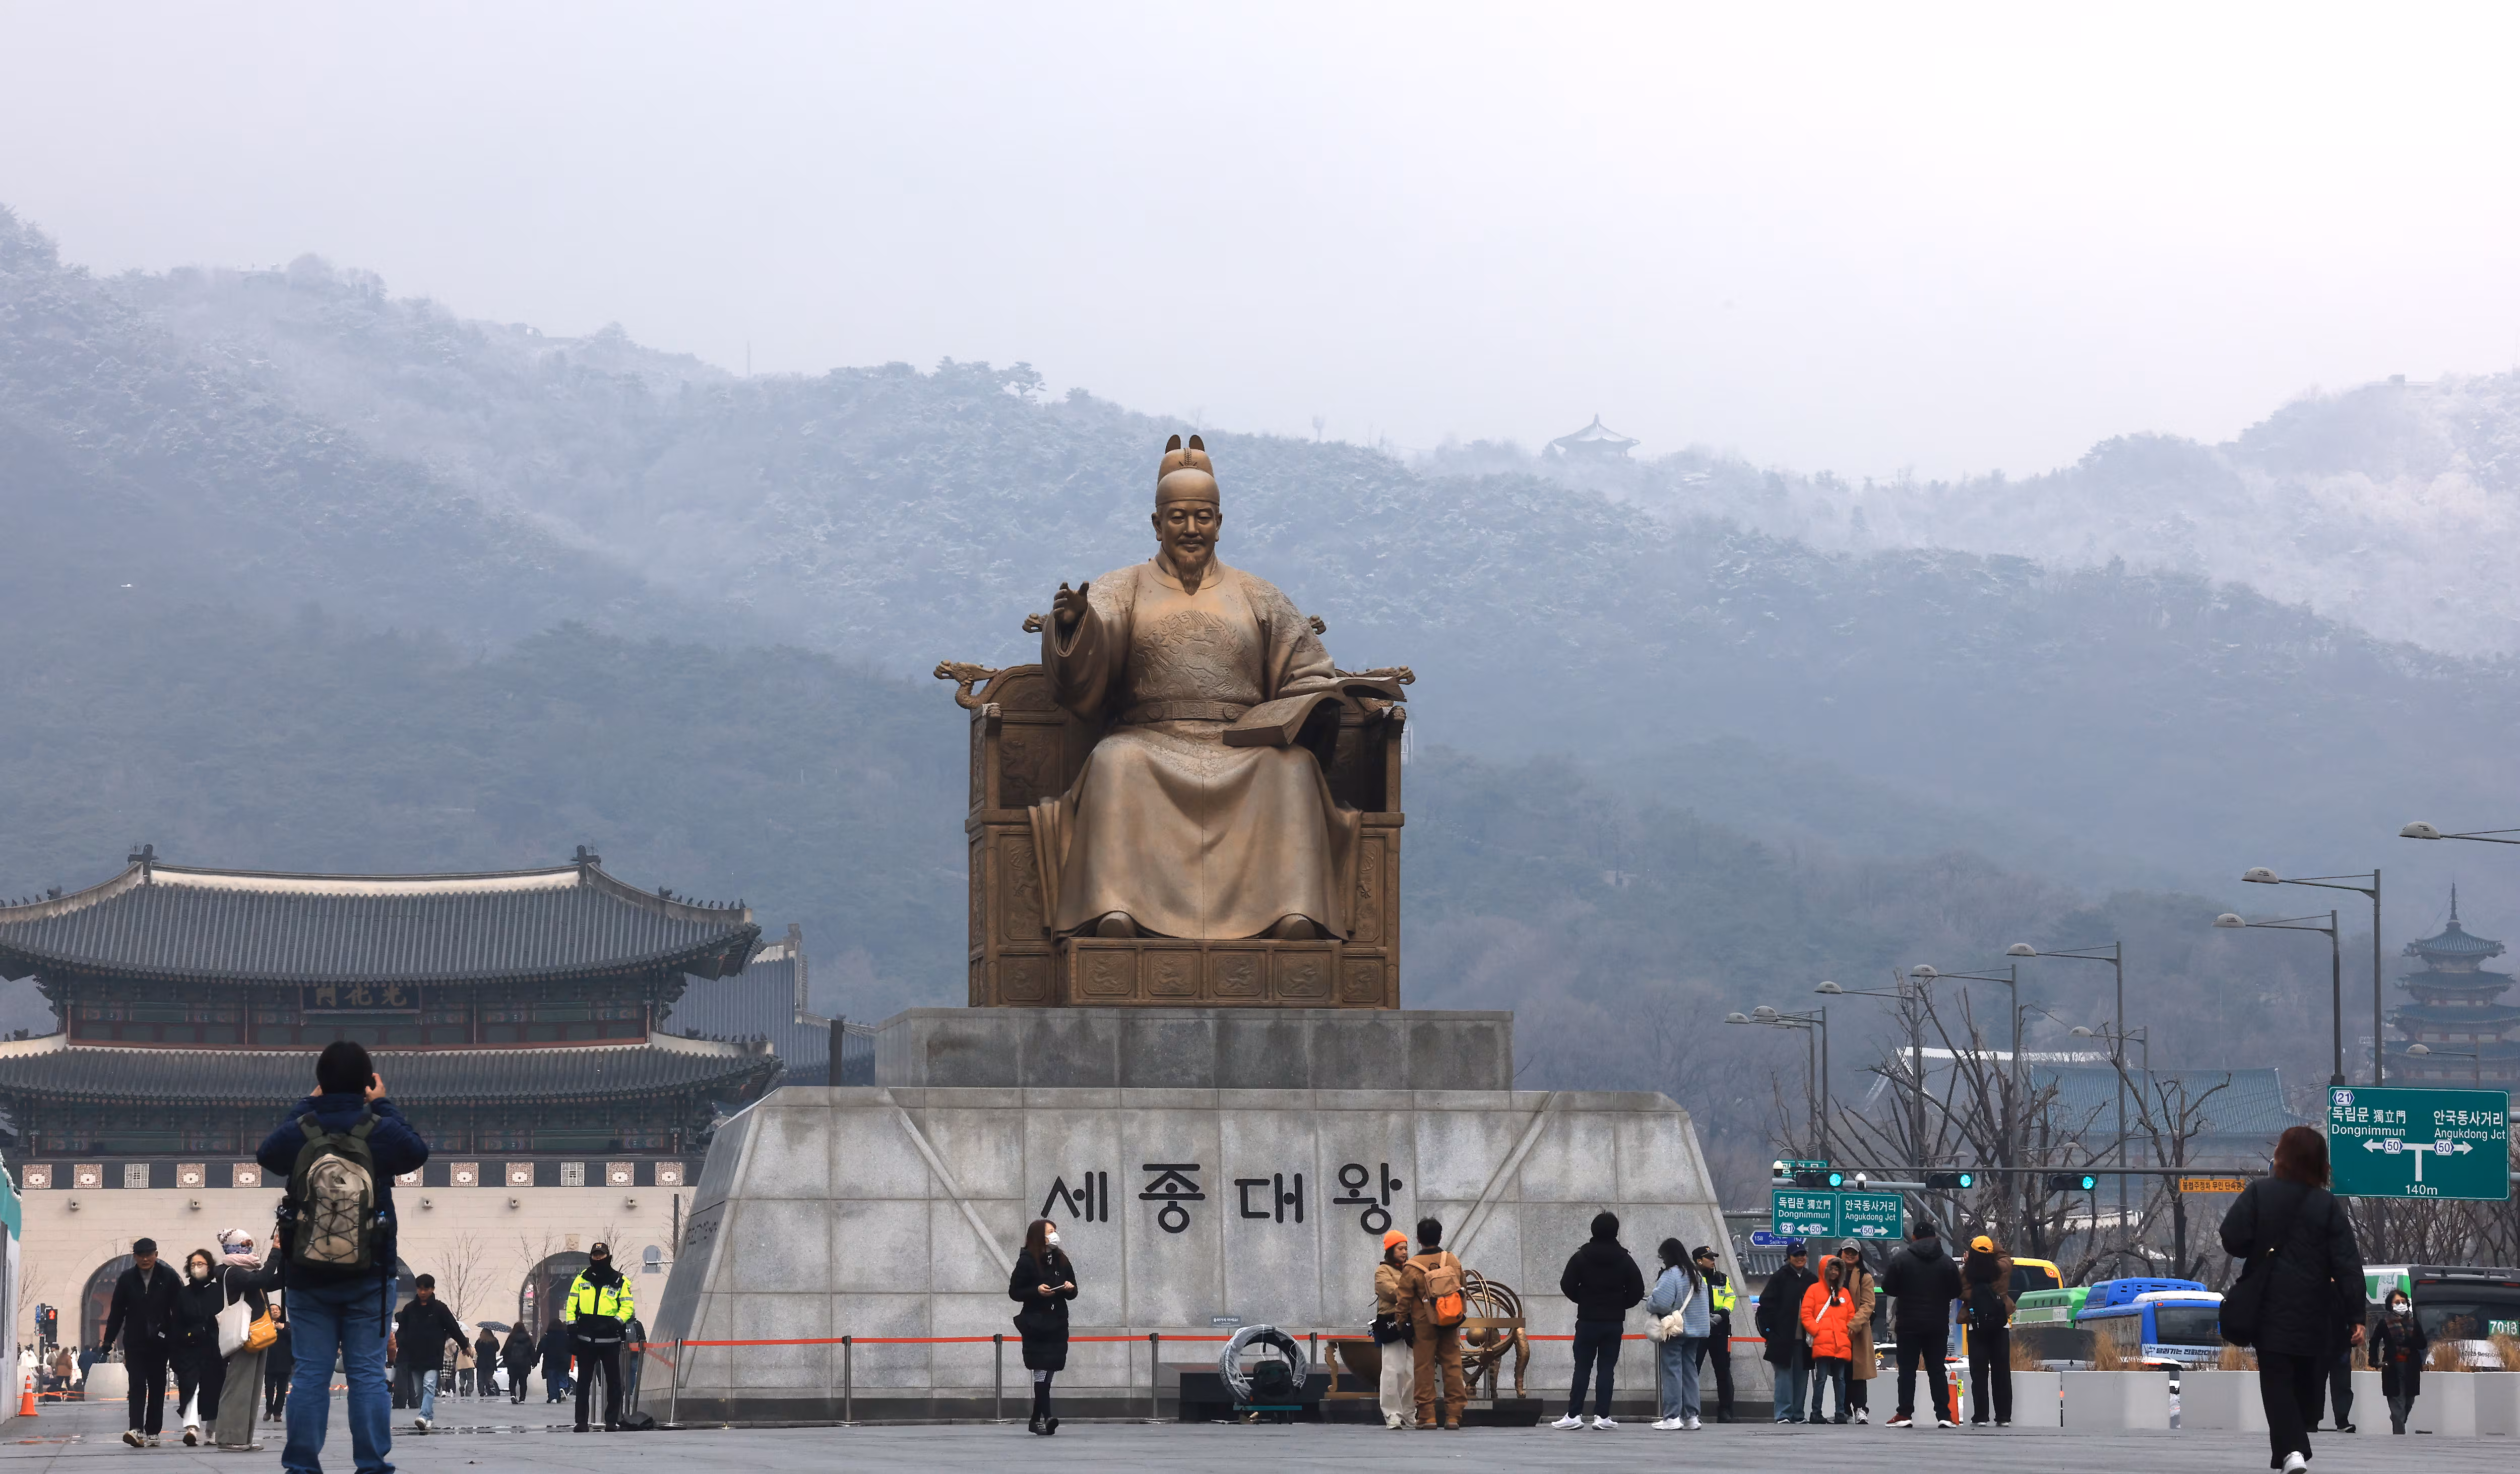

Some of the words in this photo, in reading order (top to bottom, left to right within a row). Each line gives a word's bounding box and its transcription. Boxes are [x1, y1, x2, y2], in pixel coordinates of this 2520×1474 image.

[2338, 1093, 2350, 1103] 21
[2332, 1106, 2369, 1123] 독립문
[2373, 1109, 2406, 1124] 獨立門
[2434, 1110, 2503, 1127] 안국동사거리
[2332, 1124, 2406, 1137] Dongnimmun
[2434, 1128, 2487, 1141] Angukdong
[2491, 1130, 2506, 1140] Jct
[2387, 1139, 2399, 1151] 50
[2438, 1142, 2450, 1153] 50
[2182, 1181, 2211, 1190] 불법주정차
[2212, 1182, 2223, 1190] 무인
[2406, 1184, 2438, 1195] 140m
[1041, 1162, 1403, 1235] 세종대왕
[1779, 1197, 1805, 1209] 독립문
[1807, 1199, 1831, 1210] 獨立門
[1845, 1200, 1897, 1212] 안국동사거리
[1779, 1210, 1830, 1219] Dongnimmun
[1845, 1213, 1883, 1222] Angukdong
